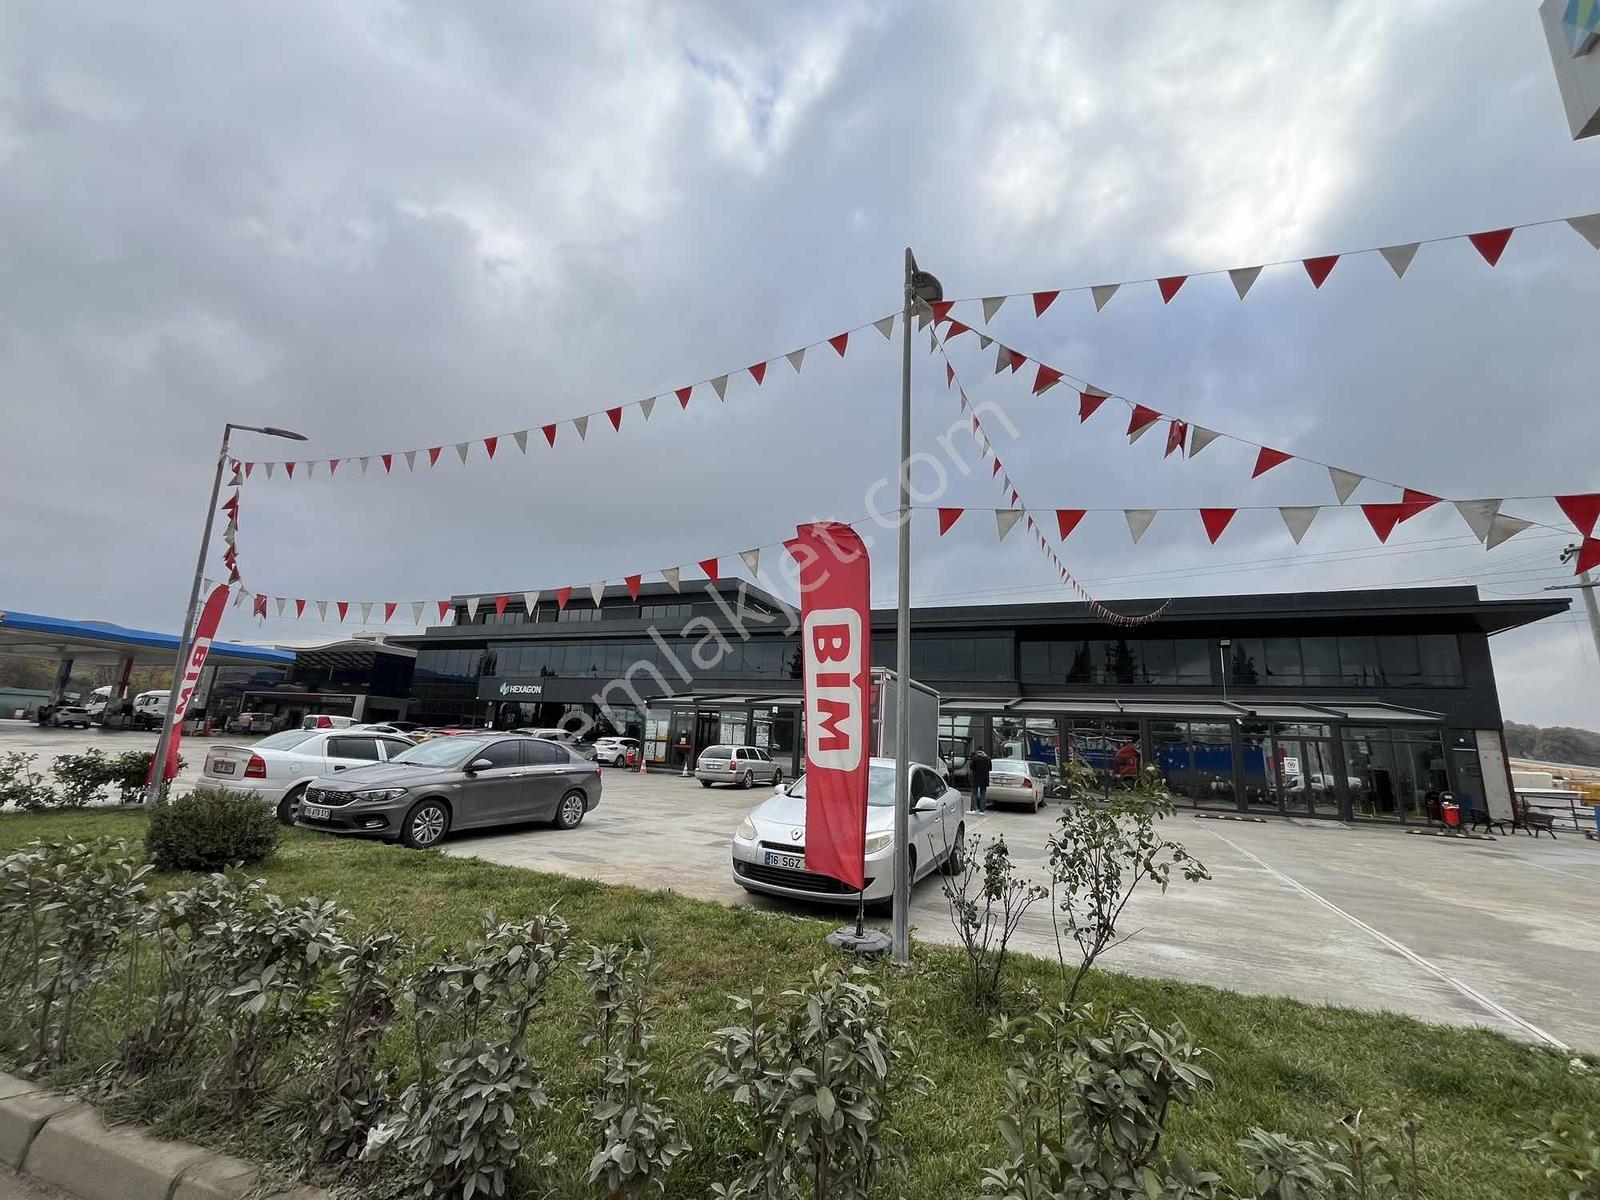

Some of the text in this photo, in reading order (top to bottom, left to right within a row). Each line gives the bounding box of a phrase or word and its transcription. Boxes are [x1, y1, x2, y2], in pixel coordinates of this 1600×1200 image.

[509, 685, 542, 694] HEXAGON
[770, 854, 802, 869] 16 SGZ
